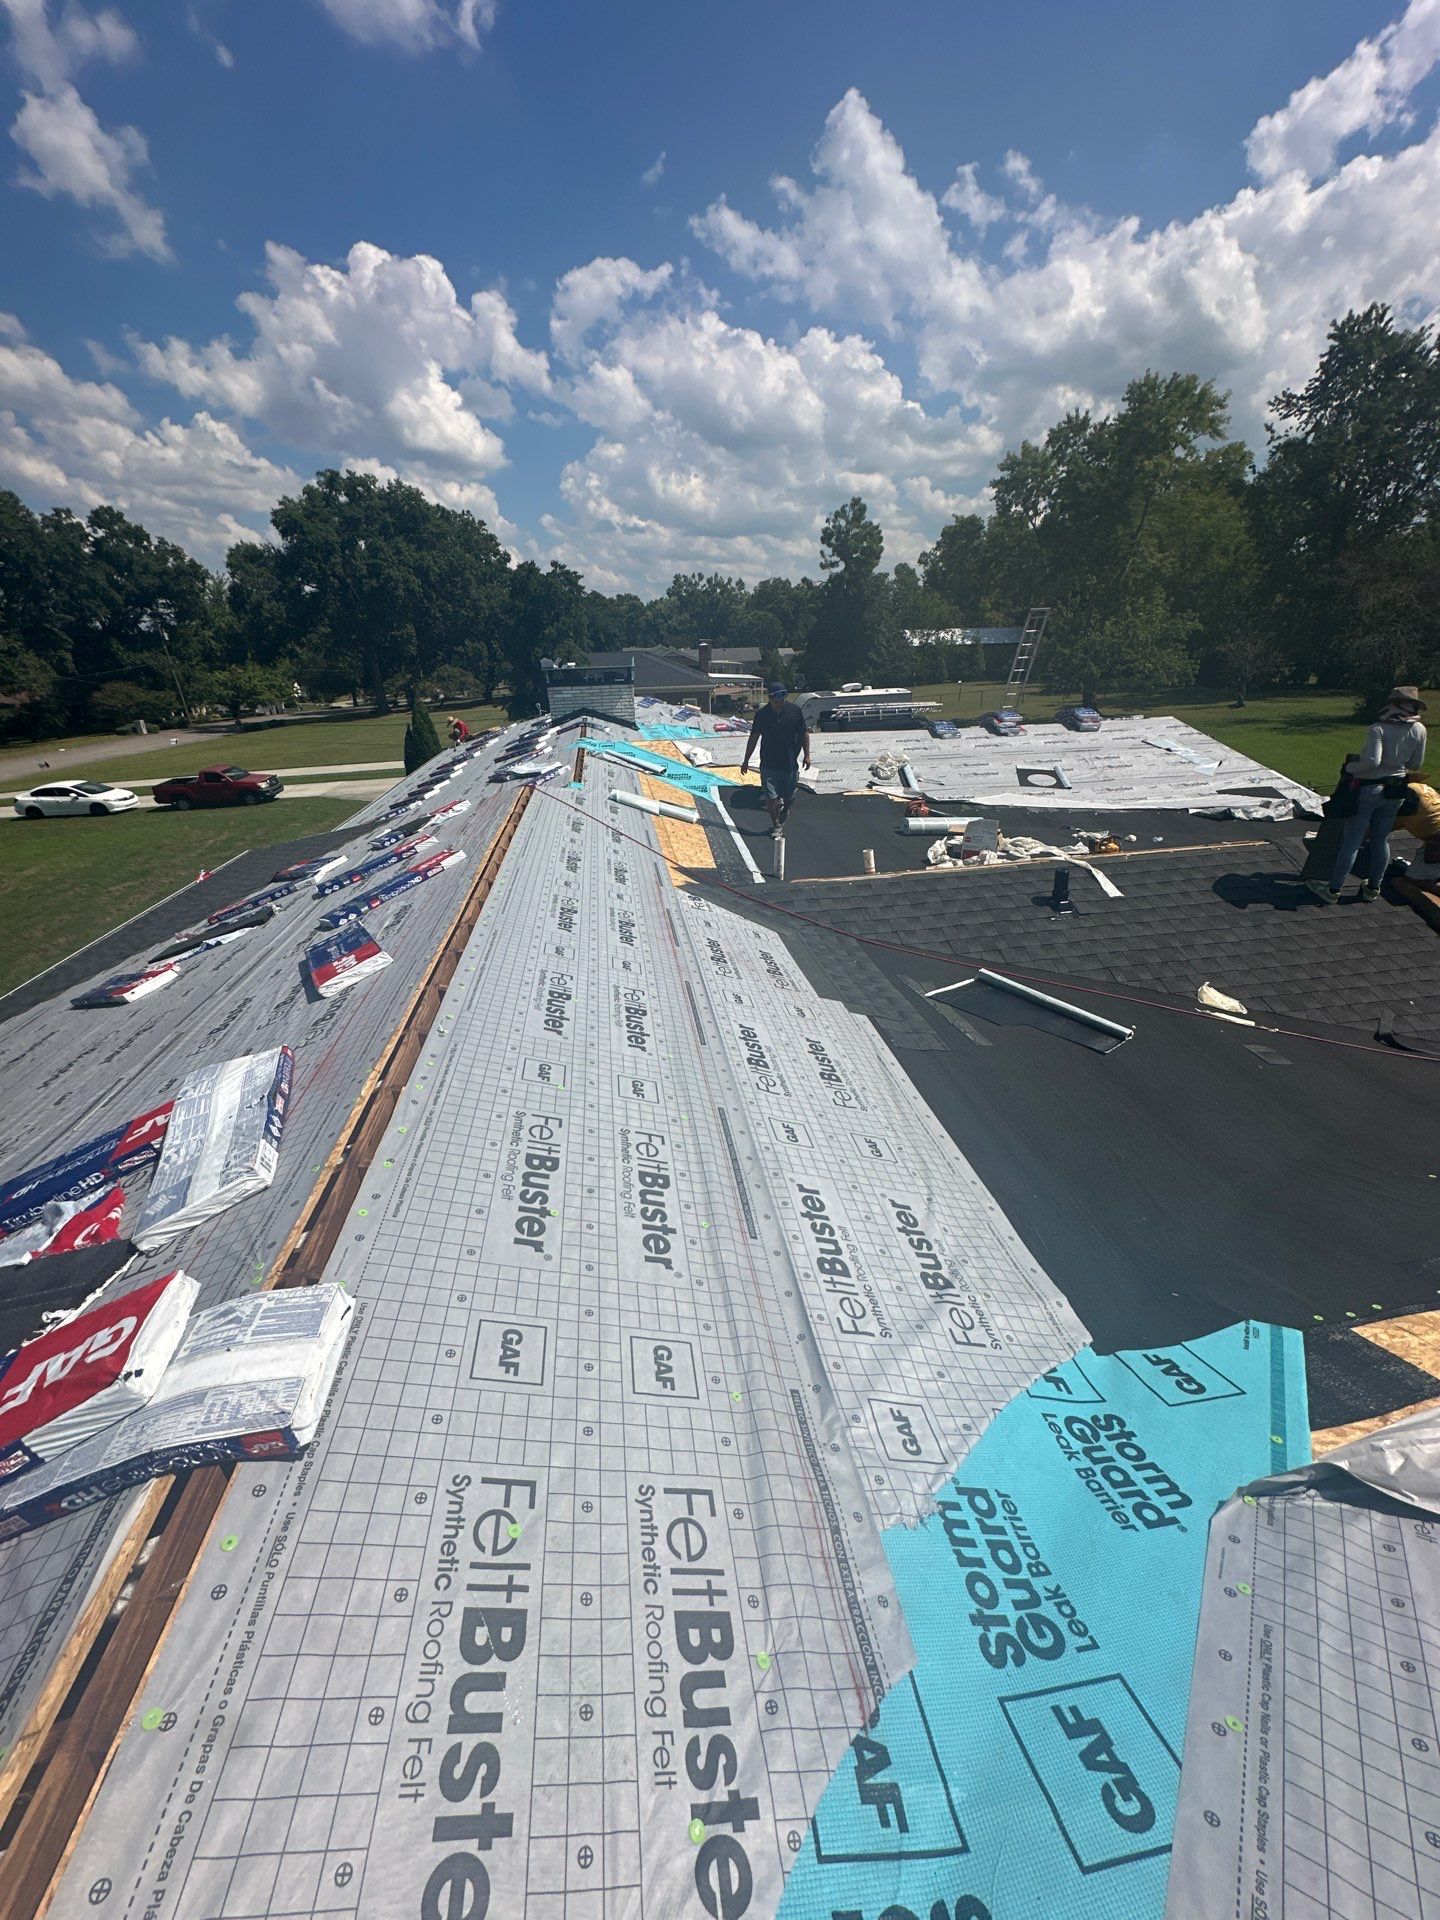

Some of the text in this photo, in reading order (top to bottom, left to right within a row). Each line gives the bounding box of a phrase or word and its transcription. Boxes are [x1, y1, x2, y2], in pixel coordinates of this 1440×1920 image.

[543, 971, 573, 1037] FeltBuster
[623, 987, 651, 1052] FeltBuster
[538, 1063, 552, 1082] GAF
[738, 1023, 781, 1095] FeltBuster
[805, 1037, 857, 1109] FeltBuster
[632, 1080, 645, 1099] GAF
[619, 1128, 631, 1165] Synthetic
[782, 1122, 799, 1142] GAF
[864, 1137, 883, 1158] GAF
[501, 1110, 526, 1201] Synthetic Roofing Felt
[514, 1113, 563, 1254] FeltBuster
[635, 1130, 677, 1270] FeltBuster
[796, 1183, 875, 1337] FeltBuster
[888, 1198, 987, 1348] FeltBuster
[837, 1225, 892, 1339] Synthetic Roofing Felt
[350, 1316, 363, 1334] ONLY
[358, 1302, 368, 1315] Use
[968, 1295, 1002, 1351] Synthetic
[0, 1316, 138, 1416] GAF
[336, 1361, 348, 1376] Cap
[342, 1336, 356, 1359] Plastic
[498, 1328, 524, 1377] GAF
[653, 1344, 676, 1391] GAF
[329, 1378, 344, 1397] Nails
[1142, 1353, 1207, 1395] GAF
[314, 1410, 331, 1438] Plastic
[325, 1400, 334, 1408] or
[306, 1440, 320, 1459] Cap
[889, 1407, 923, 1456] GAF
[294, 1461, 314, 1497] Staples
[813, 1464, 827, 1487] PARA
[1041, 1412, 1081, 1461] Leak
[1074, 1466, 1139, 1533] Barrier
[1064, 1415, 1182, 1529] Guard
[1090, 1413, 1193, 1510] Storm
[281, 1511, 296, 1533] Use
[265, 1534, 288, 1569] SÓLO
[833, 1534, 846, 1561] CON
[839, 1562, 855, 1599] EXTRA
[937, 1501, 1026, 1669] Storm
[955, 1486, 1066, 1661] Guard
[994, 1488, 1100, 1653] Leak Barrier
[46, 1581, 71, 1620] PARA
[247, 1571, 276, 1627] Puntillas
[399, 1474, 472, 1803] Synthetic Roofing Felt
[635, 1484, 678, 1789] Synthetic Roofing Felt
[850, 1603, 875, 1666] TRACCION
[1261, 1638, 1273, 1660] ONLY
[1264, 1624, 1273, 1638] Use
[223, 1631, 255, 1695] Plásticas
[1261, 1661, 1272, 1690] Plastic
[218, 1700, 228, 1709] o
[1259, 1691, 1272, 1711] Cap
[195, 1715, 226, 1774] Grapas
[1260, 1714, 1271, 1736] Nails
[1261, 1737, 1270, 1748] or
[849, 1705, 909, 1834] AF
[1050, 1704, 1156, 1834] GAF
[1258, 1749, 1271, 1785] Plastic
[185, 1780, 204, 1804] De
[1256, 1785, 1270, 1811] Cap
[156, 1810, 192, 1882] Cabeza
[1255, 1810, 1270, 1860] Staples
[1255, 1869, 1268, 1896] Use
